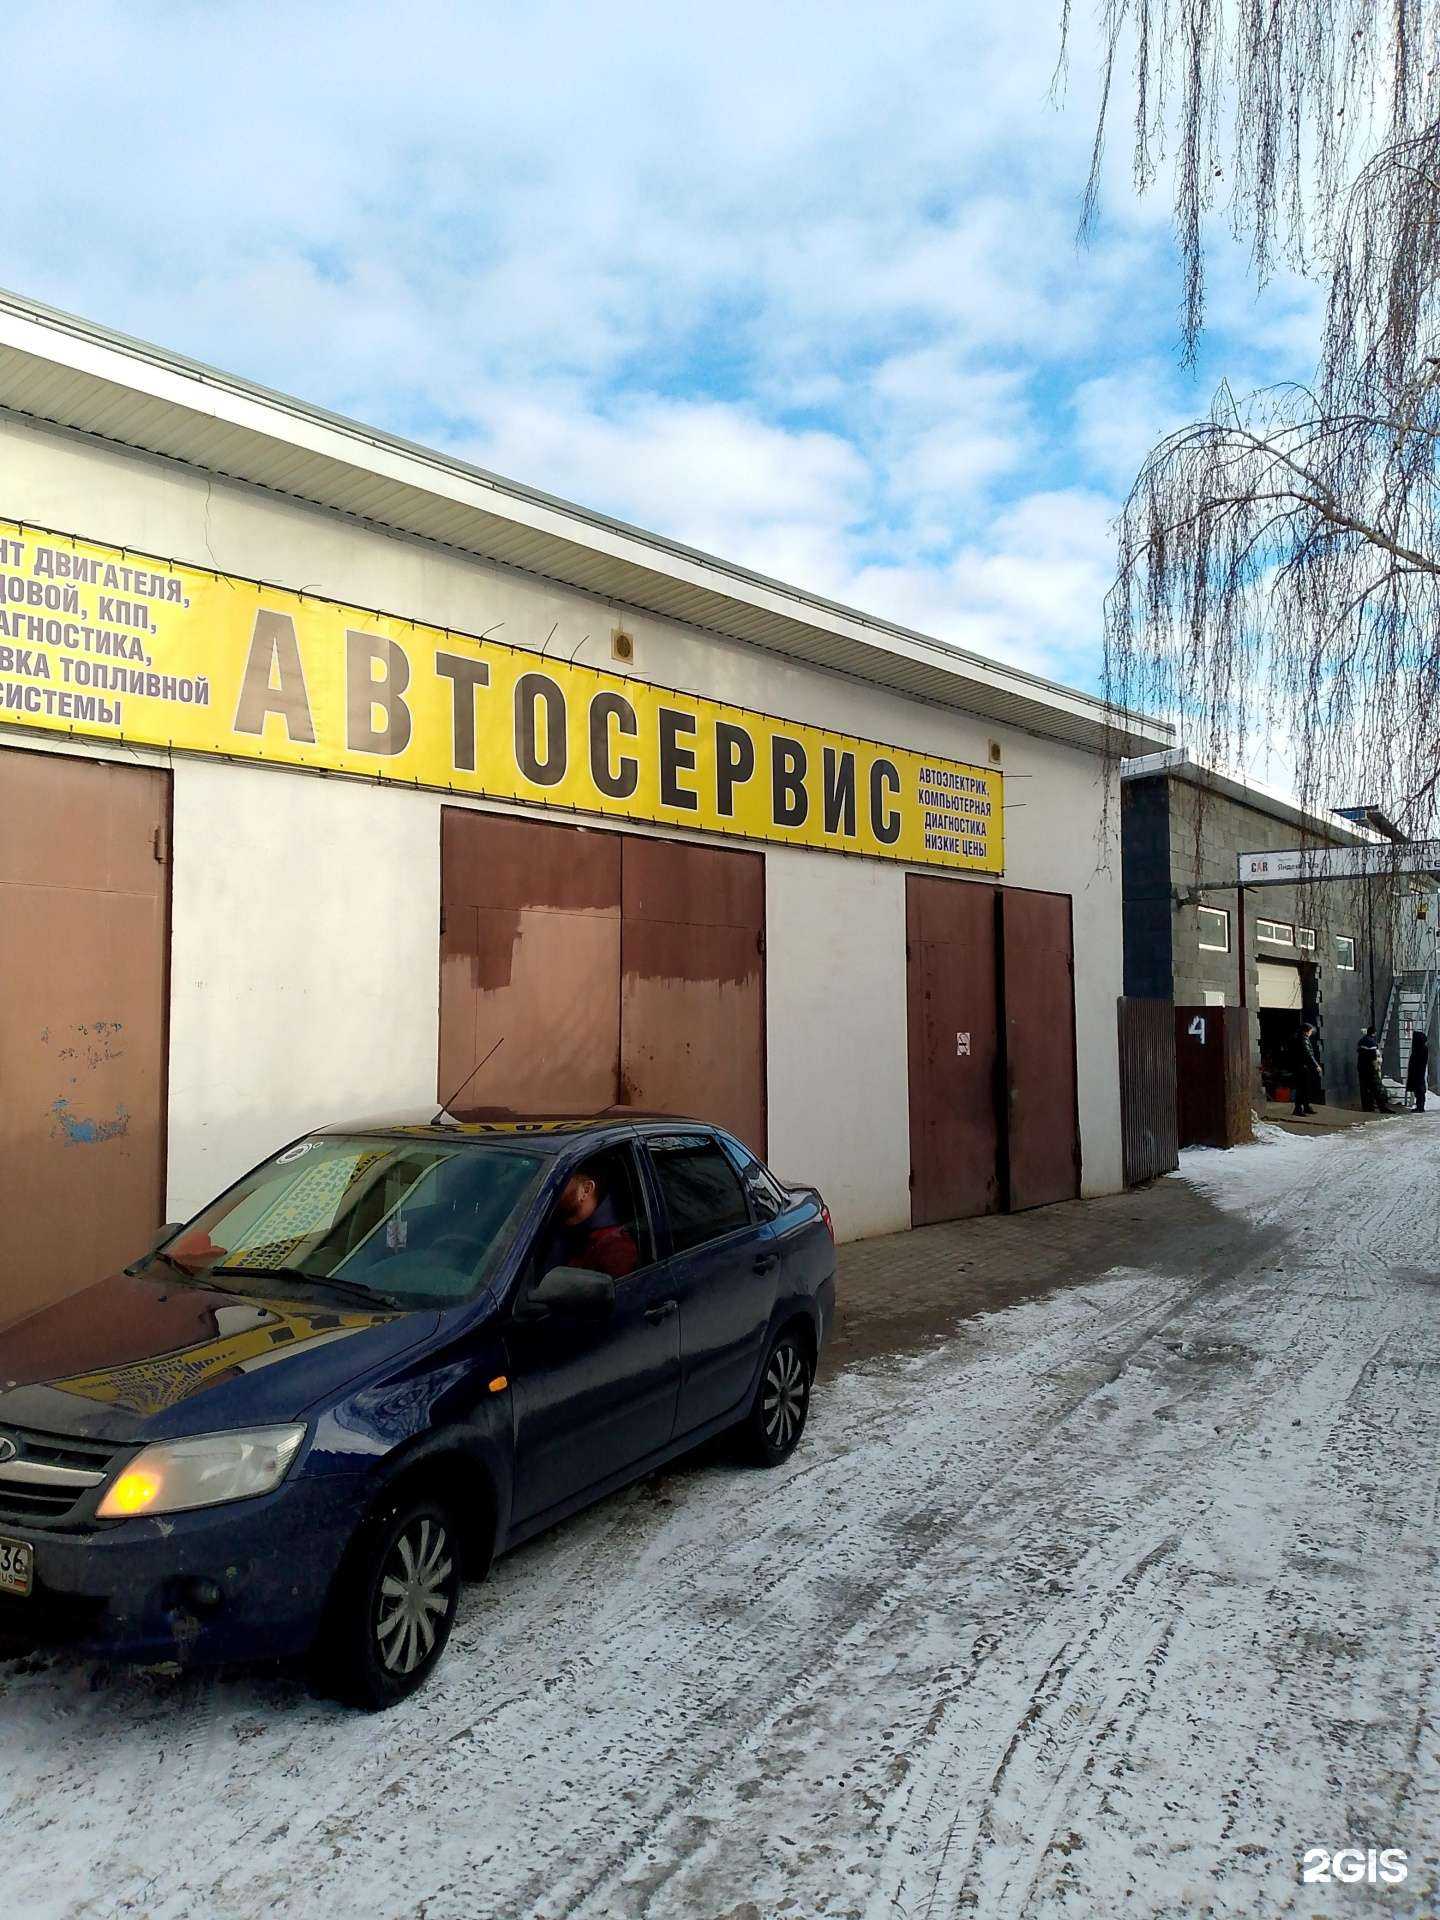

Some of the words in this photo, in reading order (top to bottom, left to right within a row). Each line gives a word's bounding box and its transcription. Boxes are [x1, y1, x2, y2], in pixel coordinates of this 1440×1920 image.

[33, 547, 190, 608] ДВИГАТЕЛЯ,
[98, 596, 157, 634] КПП,
[0, 646, 51, 679] ВКА
[59, 656, 209, 706] ТОПЛИВНОЙ
[0, 681, 121, 725] ИСТЕМЫ
[233, 608, 901, 844] АВТОСЕРВИС
[918, 788, 991, 817] КОМПЬЮТЕРНАЯ
[924, 811, 987, 837] ДИАГНОСТИКА
[924, 833, 960, 854] НИЗКИЕ
[961, 839, 987, 858] ЦЕНЫ
[1188, 1015, 1205, 1044] 4
